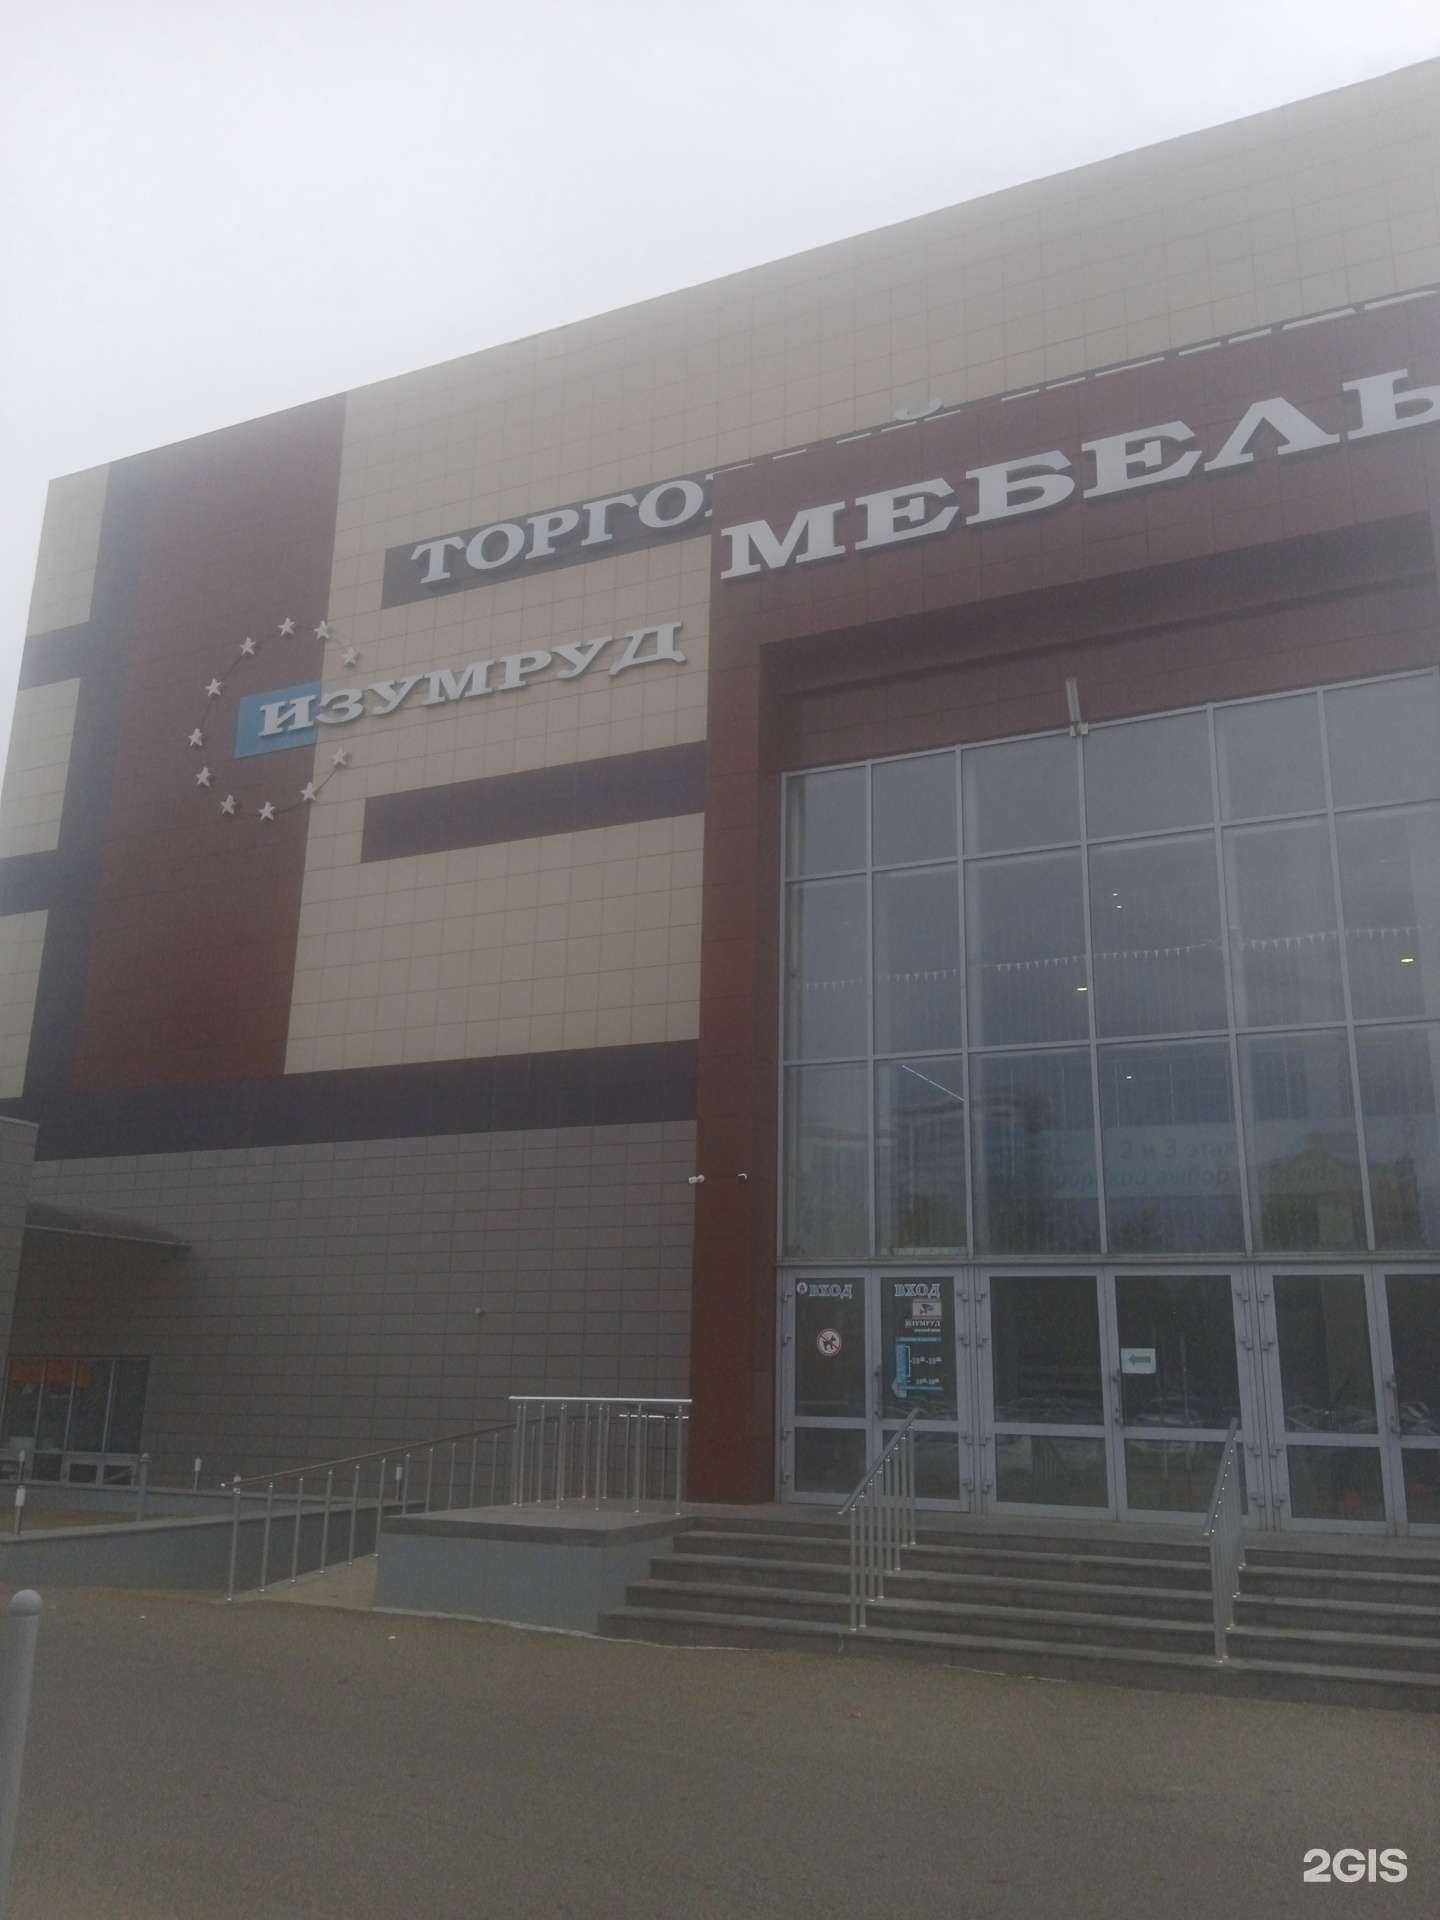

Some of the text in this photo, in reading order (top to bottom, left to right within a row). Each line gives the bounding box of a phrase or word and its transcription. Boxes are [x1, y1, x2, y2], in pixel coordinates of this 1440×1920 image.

[410, 473, 714, 584] ТОРГО
[720, 368, 1440, 580] МЕБЕЛЬ
[258, 621, 688, 738] ИЗУМРУД
[809, 1284, 853, 1299] ВХОД
[894, 1283, 941, 1298] ВХОД
